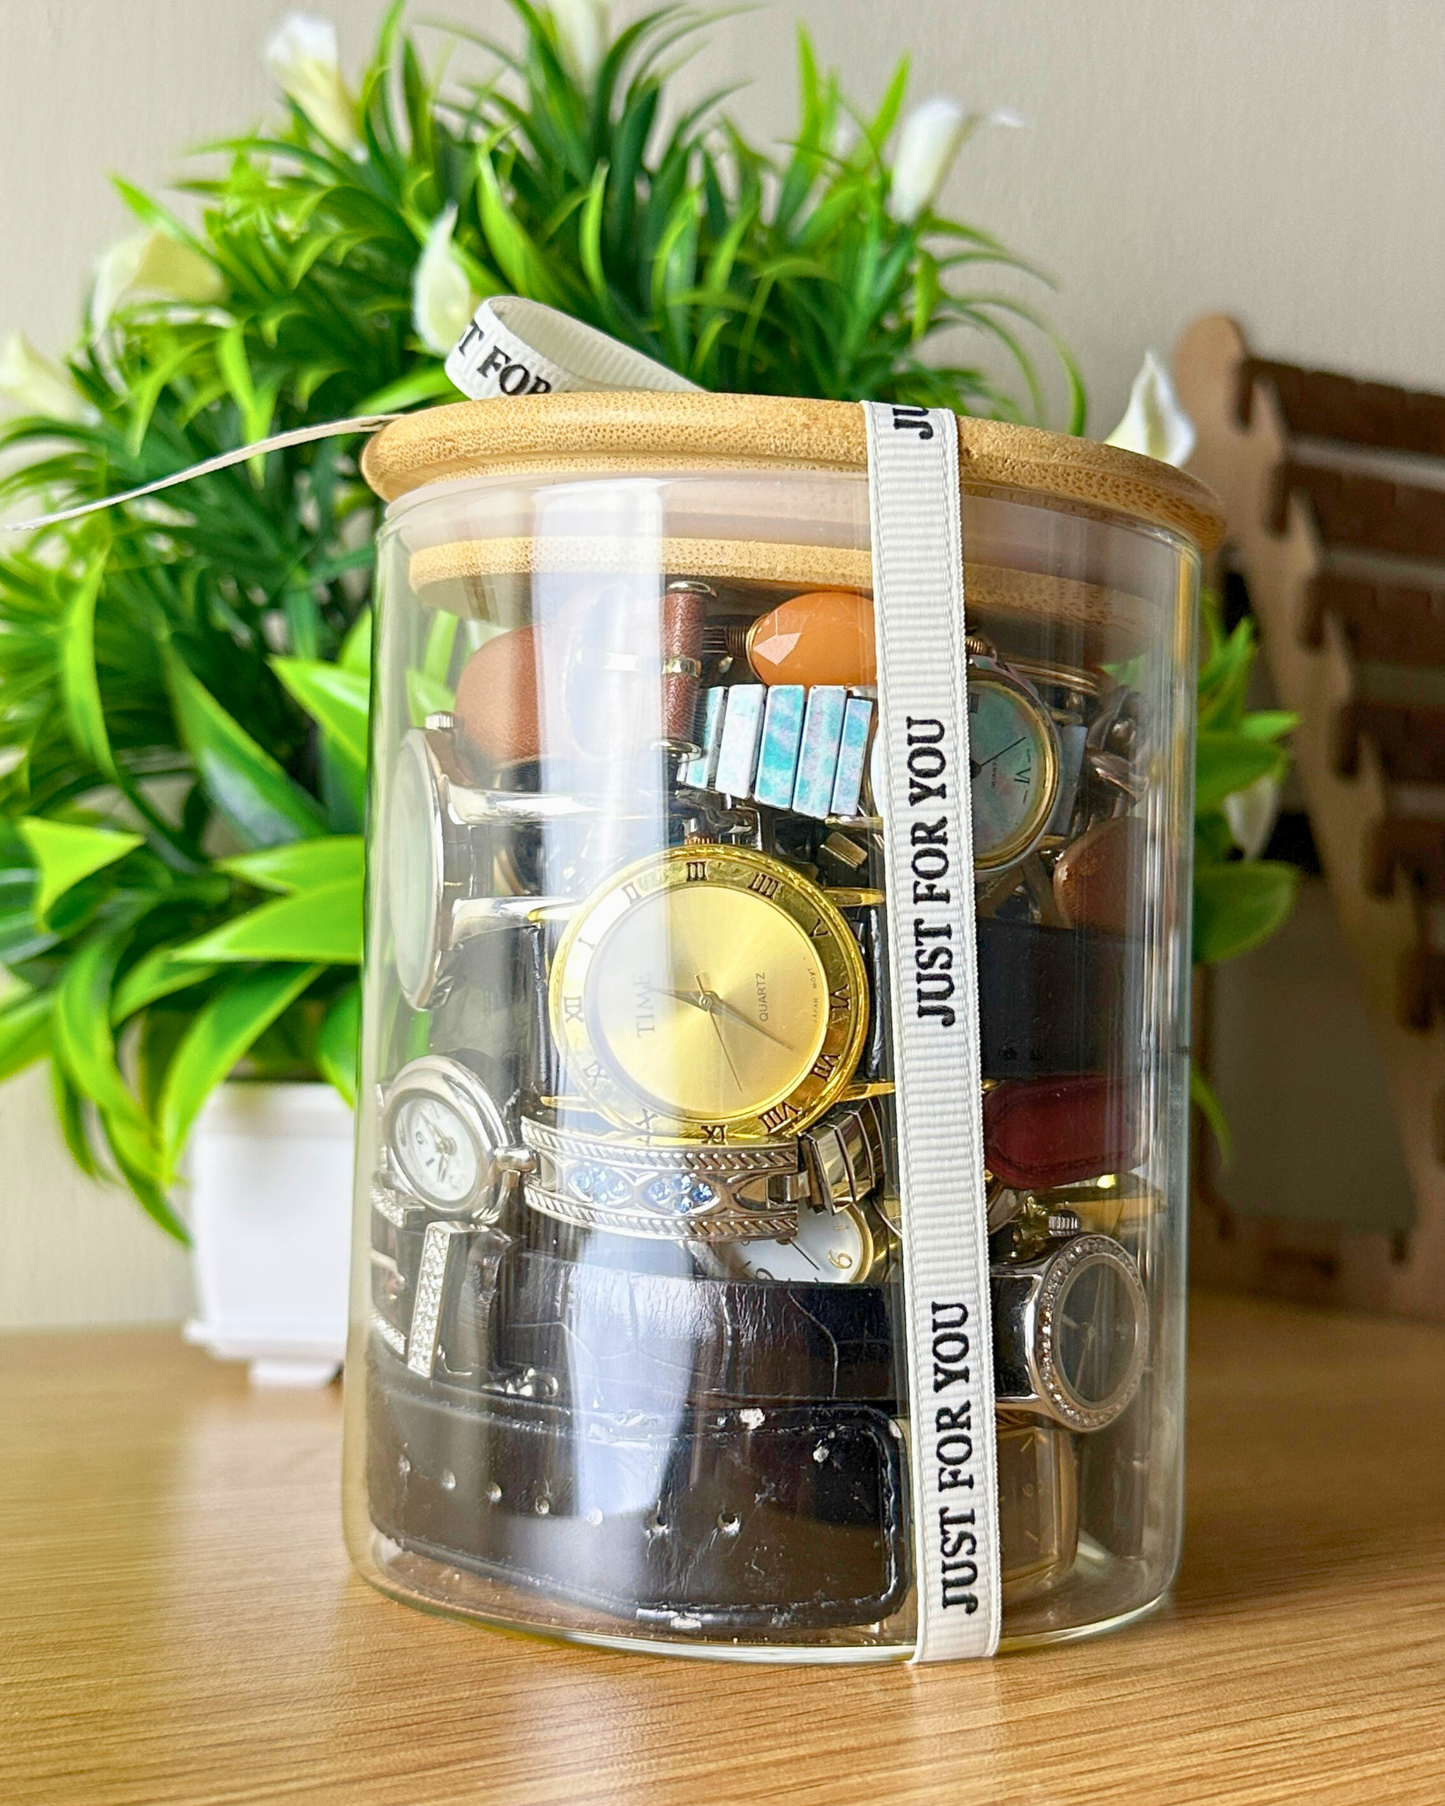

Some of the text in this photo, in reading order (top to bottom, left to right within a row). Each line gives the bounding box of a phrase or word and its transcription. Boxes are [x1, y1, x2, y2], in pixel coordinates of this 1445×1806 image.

[686, 861, 708, 882] III
[906, 715, 956, 1028] JUST FOR YOU
[809, 918, 832, 938] V
[564, 995, 584, 1023] XII
[633, 971, 655, 1039] TIME
[756, 972, 769, 1022] QUARTZ
[829, 983, 850, 1011] VI
[931, 1301, 979, 1615] JUST FOR YOU
